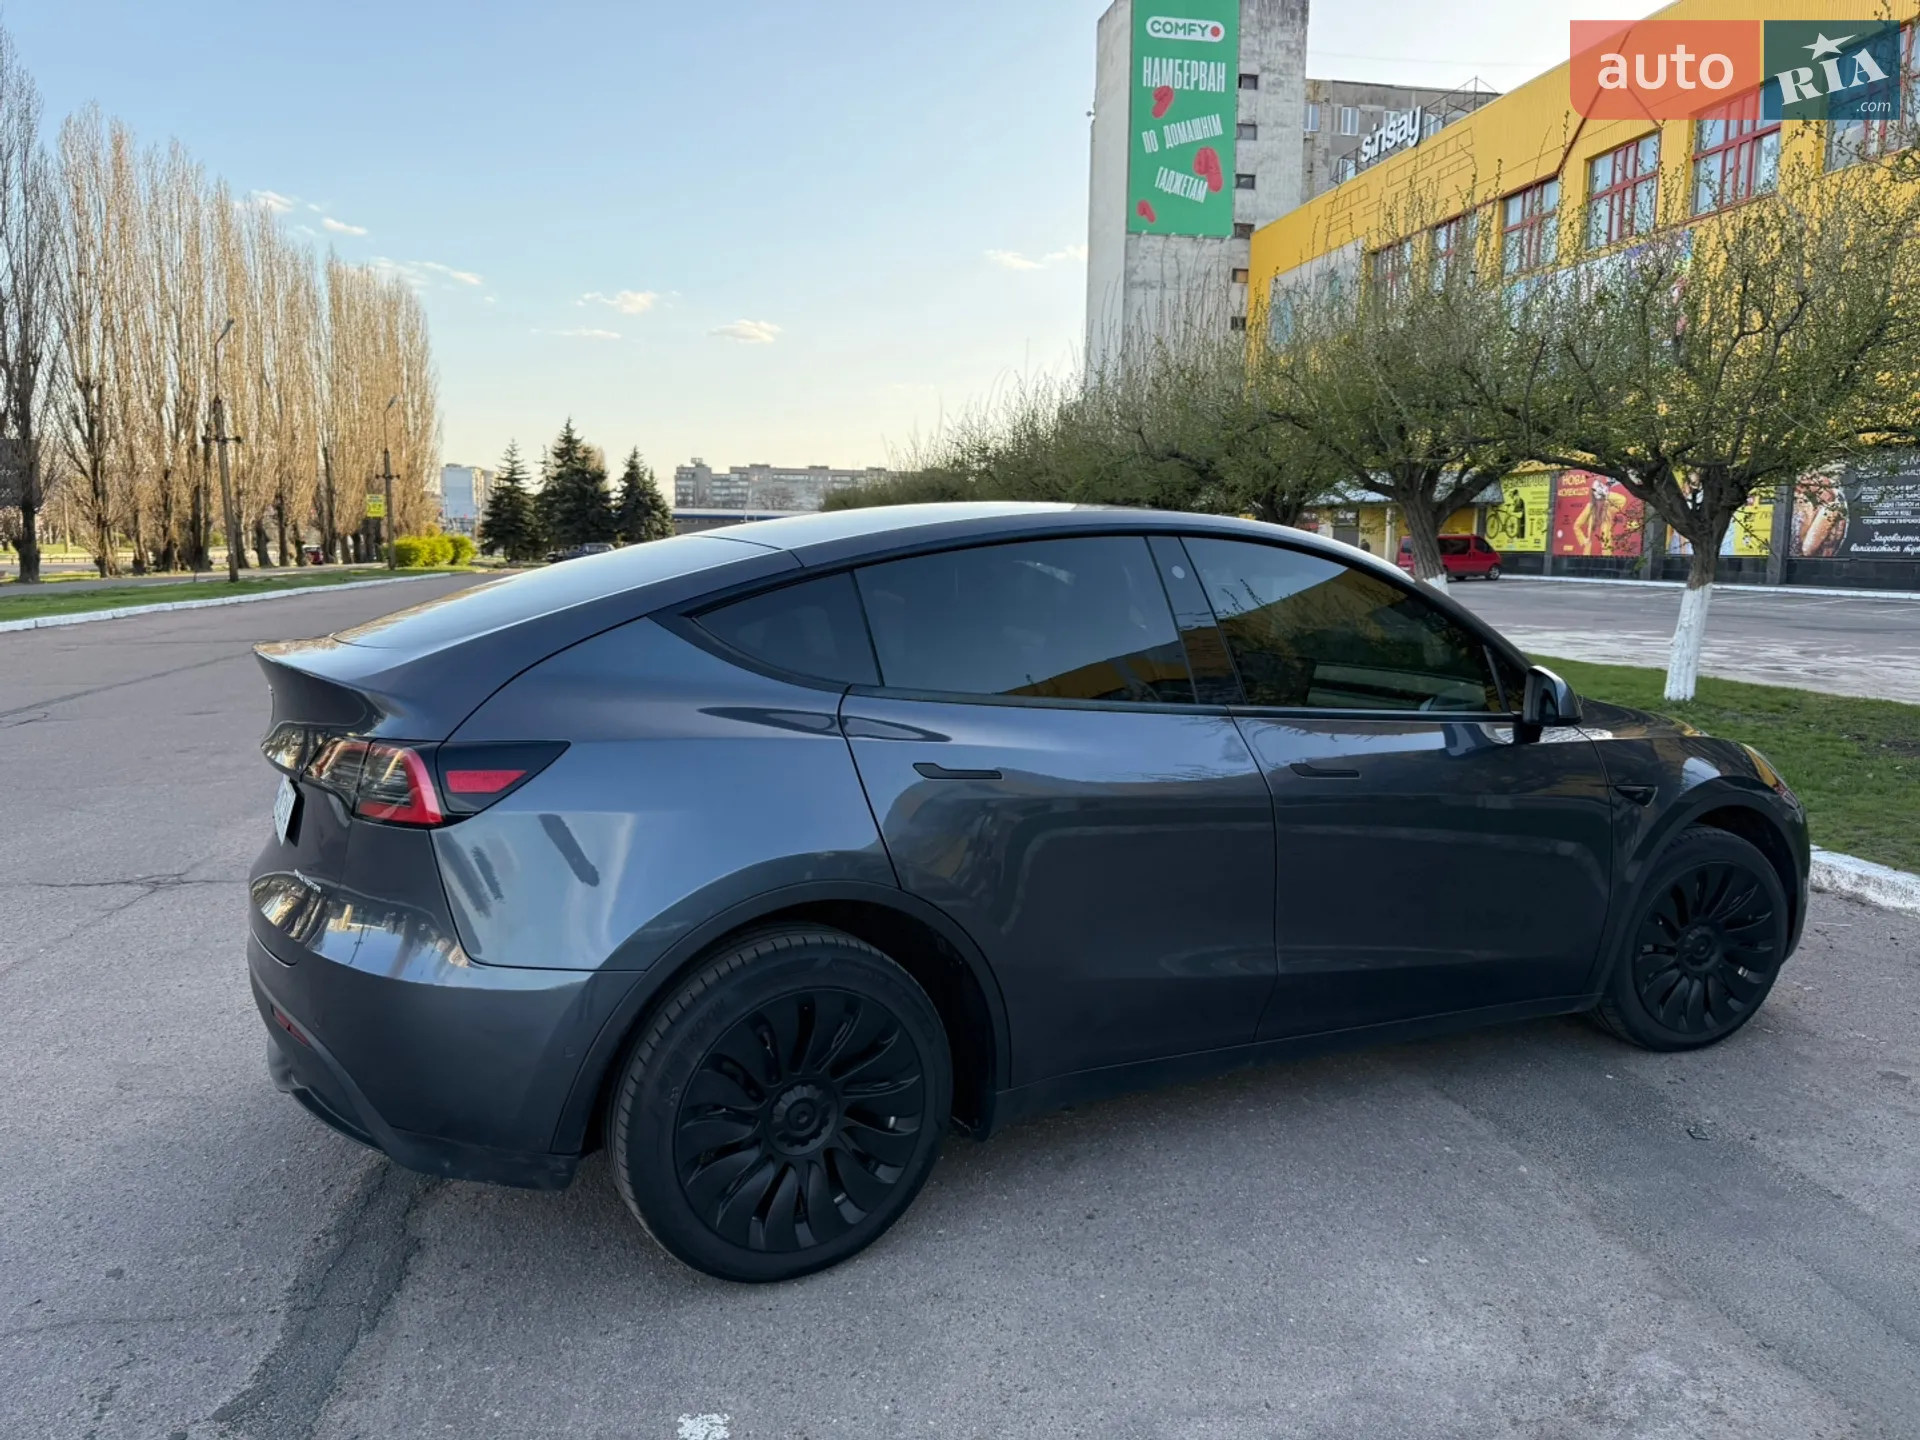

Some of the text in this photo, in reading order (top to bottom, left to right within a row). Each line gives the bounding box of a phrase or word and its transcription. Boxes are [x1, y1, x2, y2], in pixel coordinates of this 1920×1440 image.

[1150, 19, 1210, 38] COMFY
[1143, 56, 1226, 92] НАМБЕРВАН
[1142, 113, 1223, 154] ПО ДОМАШНІМ
[1360, 105, 1422, 162] sinsay
[1154, 166, 1208, 203] ГАДЖЕТАМ
